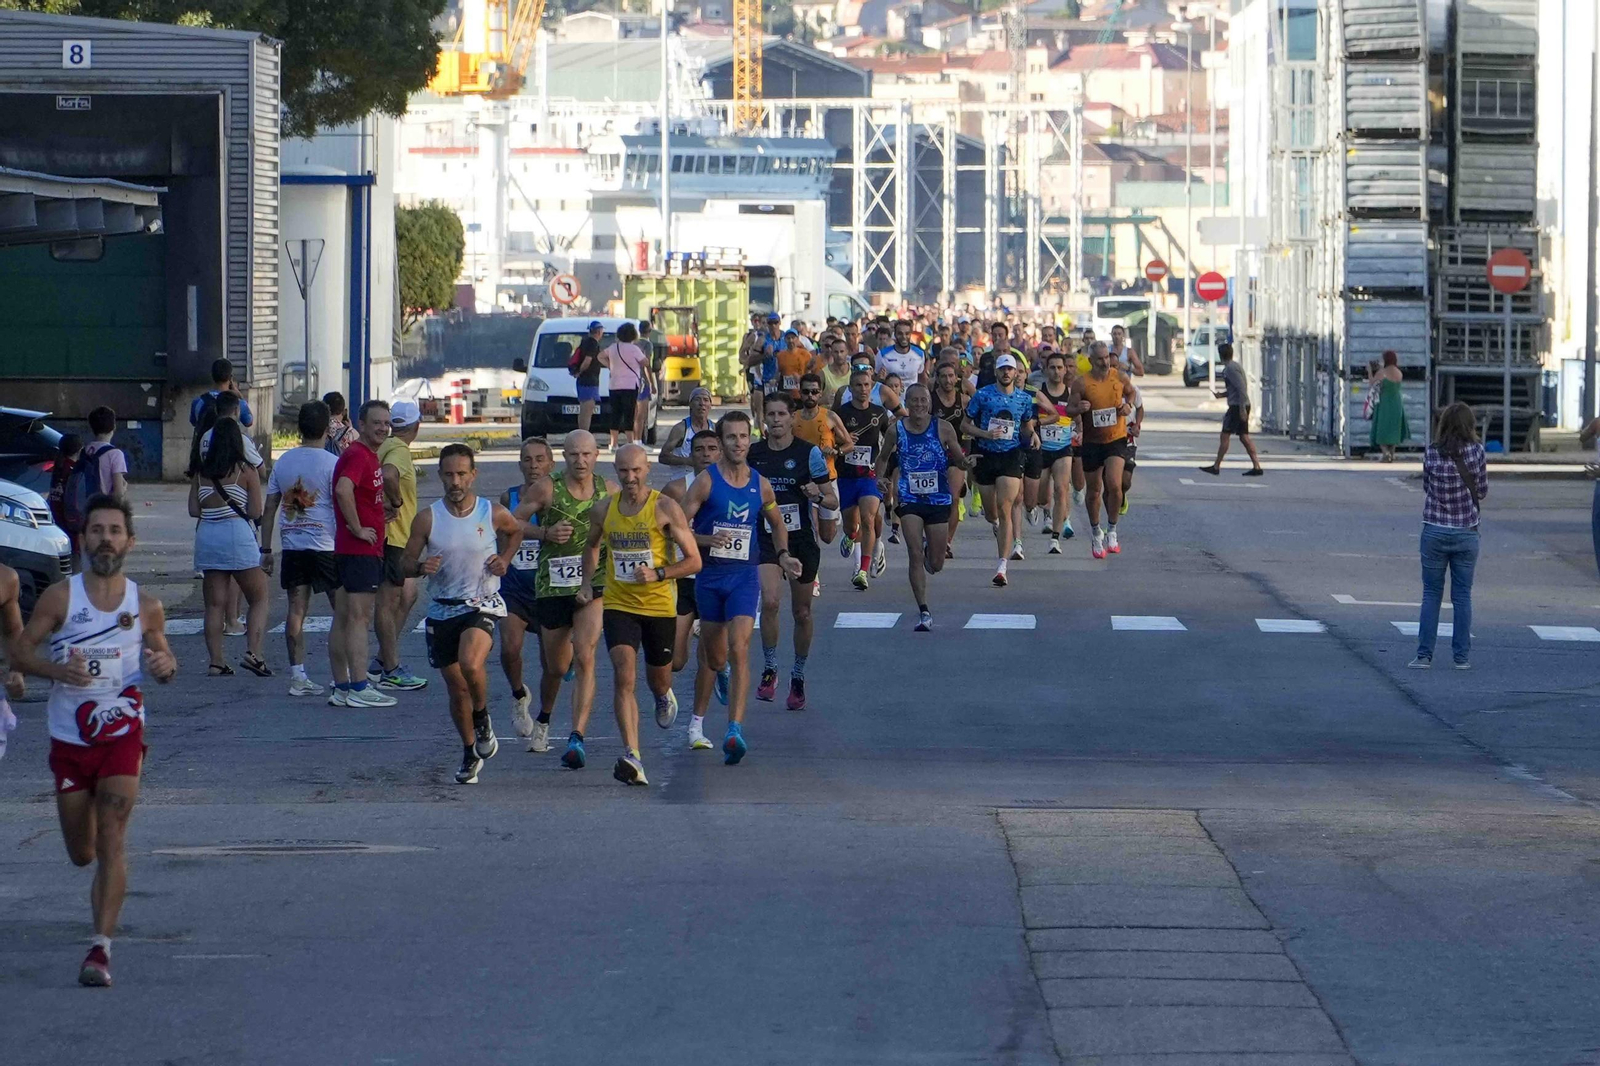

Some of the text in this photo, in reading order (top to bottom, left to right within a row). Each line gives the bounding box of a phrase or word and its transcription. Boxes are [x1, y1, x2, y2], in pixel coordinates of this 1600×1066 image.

[70, 44, 84, 64] 8
[1100, 413, 1112, 422] 67
[852, 452, 865, 461] 57
[914, 478, 935, 488] 105
[557, 565, 583, 578] 128
[88, 659, 102, 677] 8
